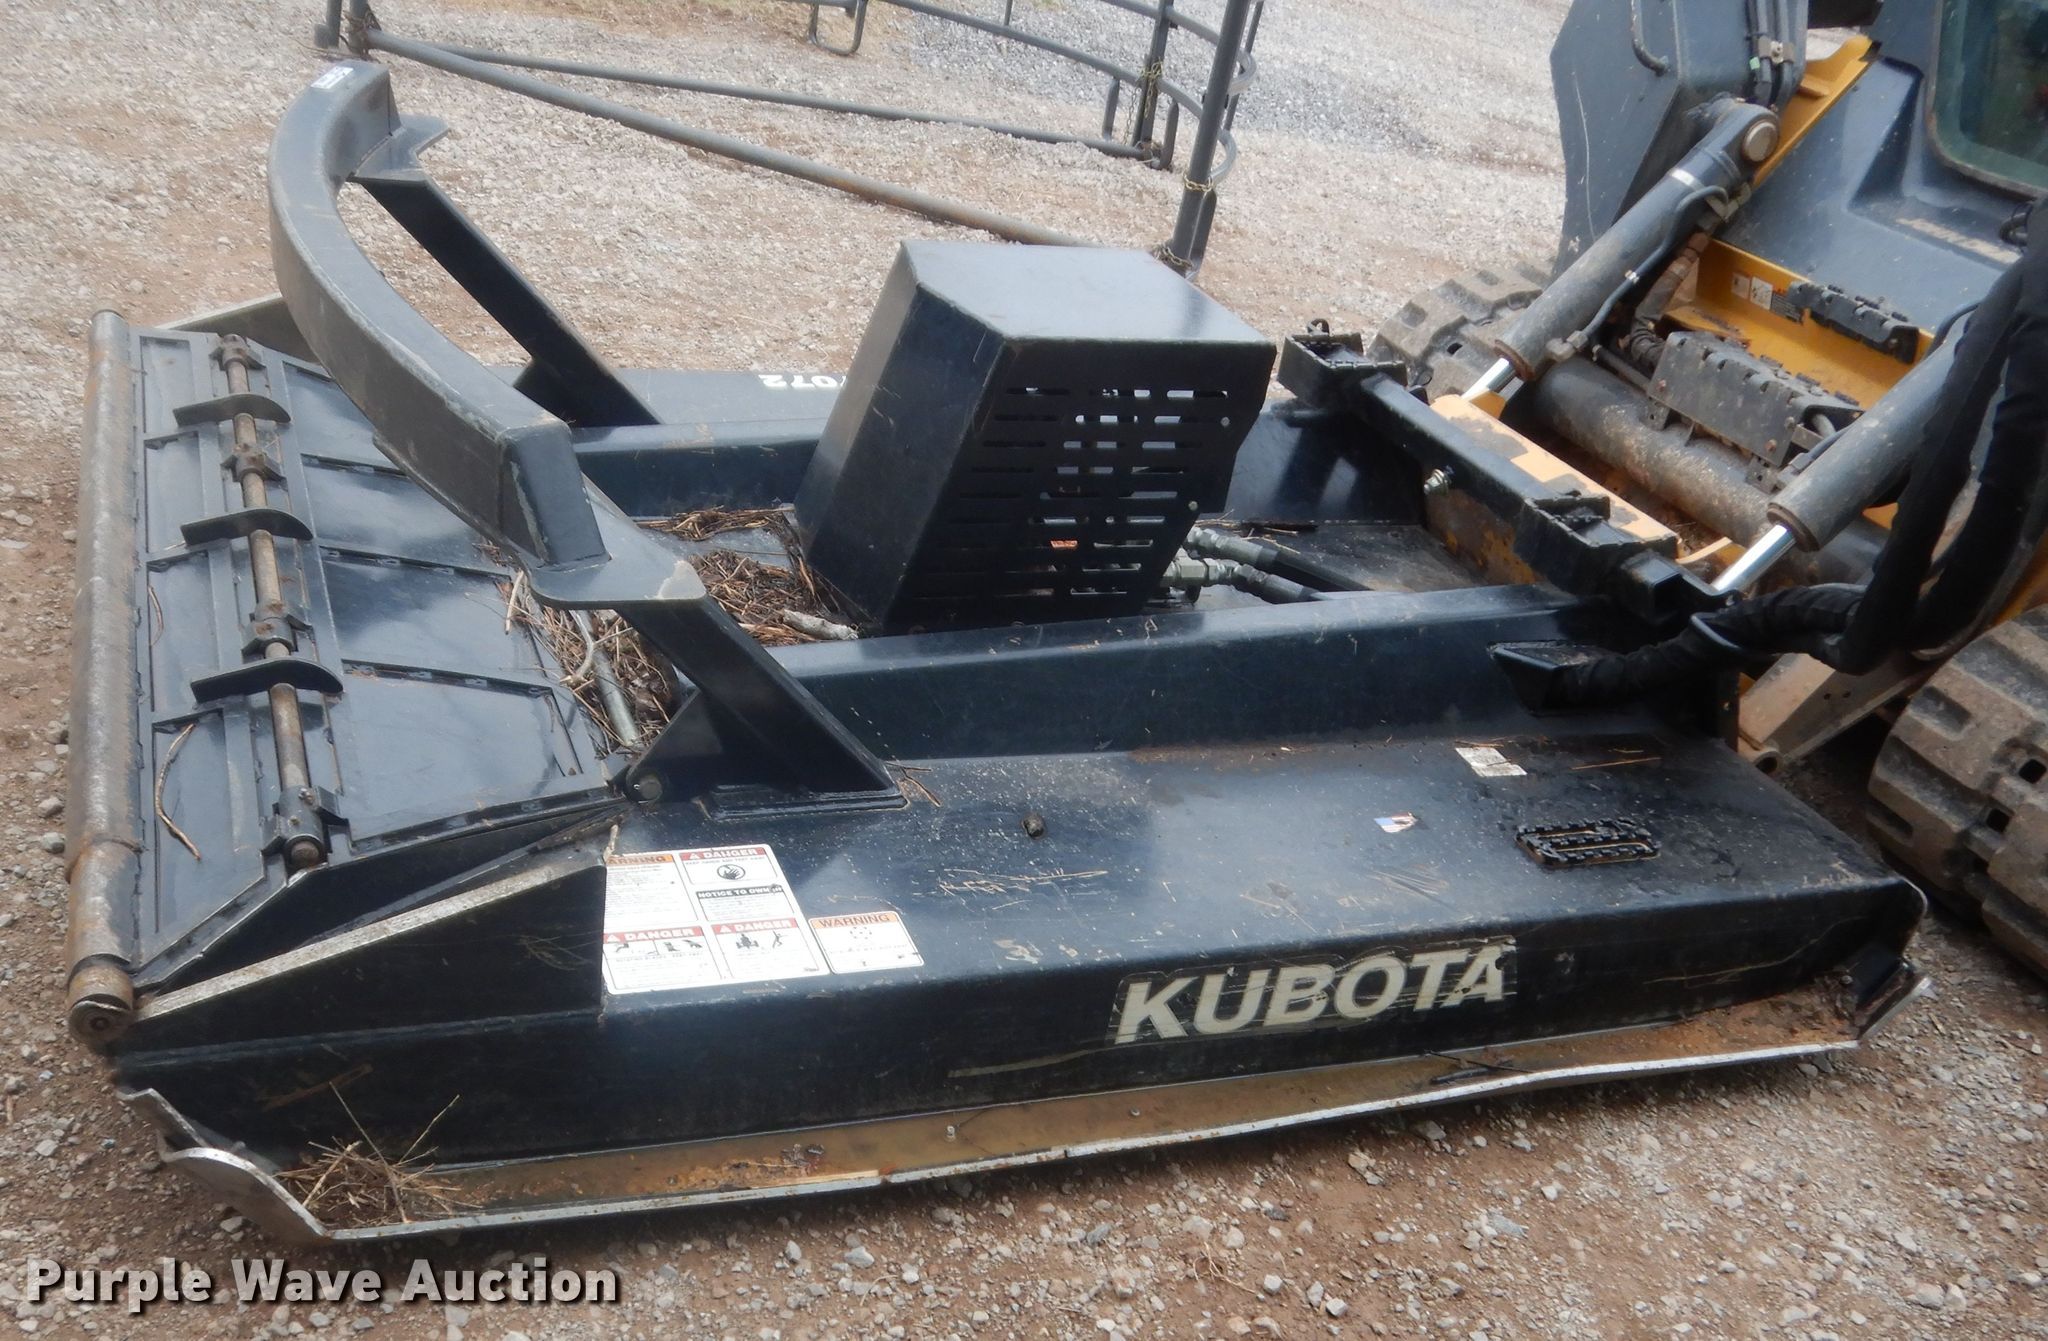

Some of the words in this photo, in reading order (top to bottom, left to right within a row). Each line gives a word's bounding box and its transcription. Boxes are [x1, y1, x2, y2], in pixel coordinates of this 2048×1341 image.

[758, 374, 847, 388] 072
[703, 848, 758, 859] DANGER
[606, 855, 666, 866] ARNING
[698, 890, 733, 899] NOTICE
[734, 919, 792, 932] DANGER
[819, 913, 890, 928] WARNING
[624, 928, 694, 941] DANGER
[1114, 943, 1506, 1045] KUBOTA
